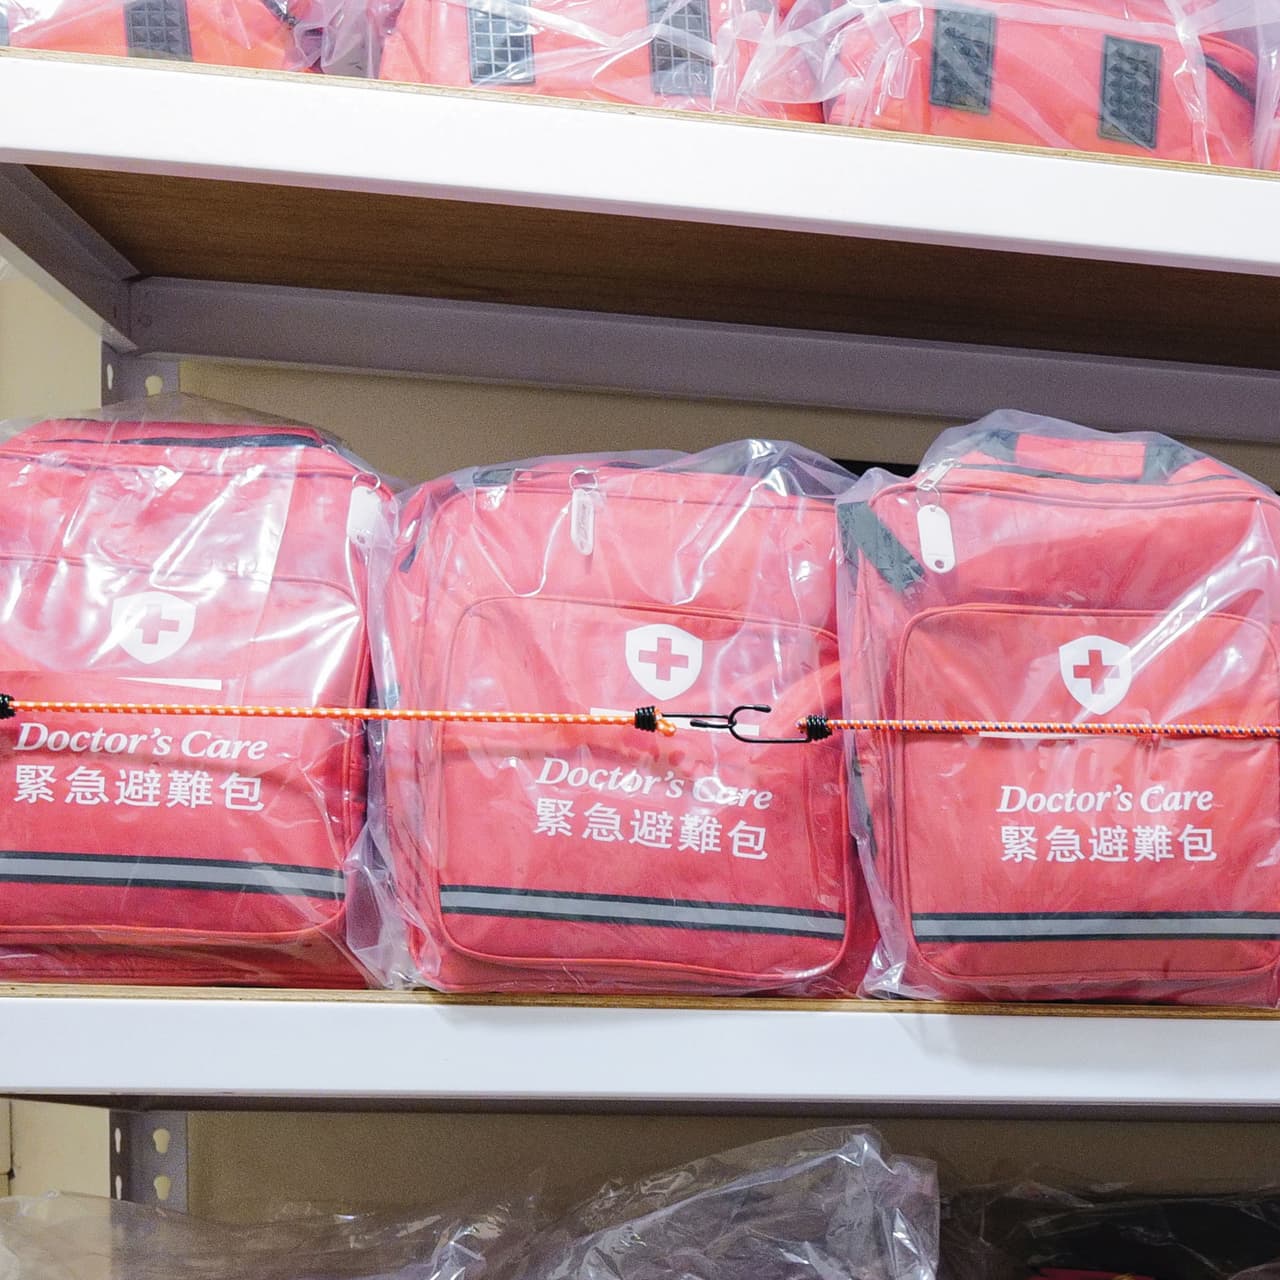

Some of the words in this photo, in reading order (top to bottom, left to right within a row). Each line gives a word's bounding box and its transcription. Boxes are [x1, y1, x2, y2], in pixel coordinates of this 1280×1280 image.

[13, 721, 171, 757] Doctor's
[181, 729, 269, 761] Care
[13, 763, 266, 813] 緊急避難包
[536, 756, 684, 801] Doctor's
[693, 775, 774, 811] Care
[996, 785, 1132, 813] Doctor's
[1140, 785, 1213, 813] Care
[534, 798, 769, 862] 緊急避難包
[1001, 824, 1217, 863] 緊急避難包
